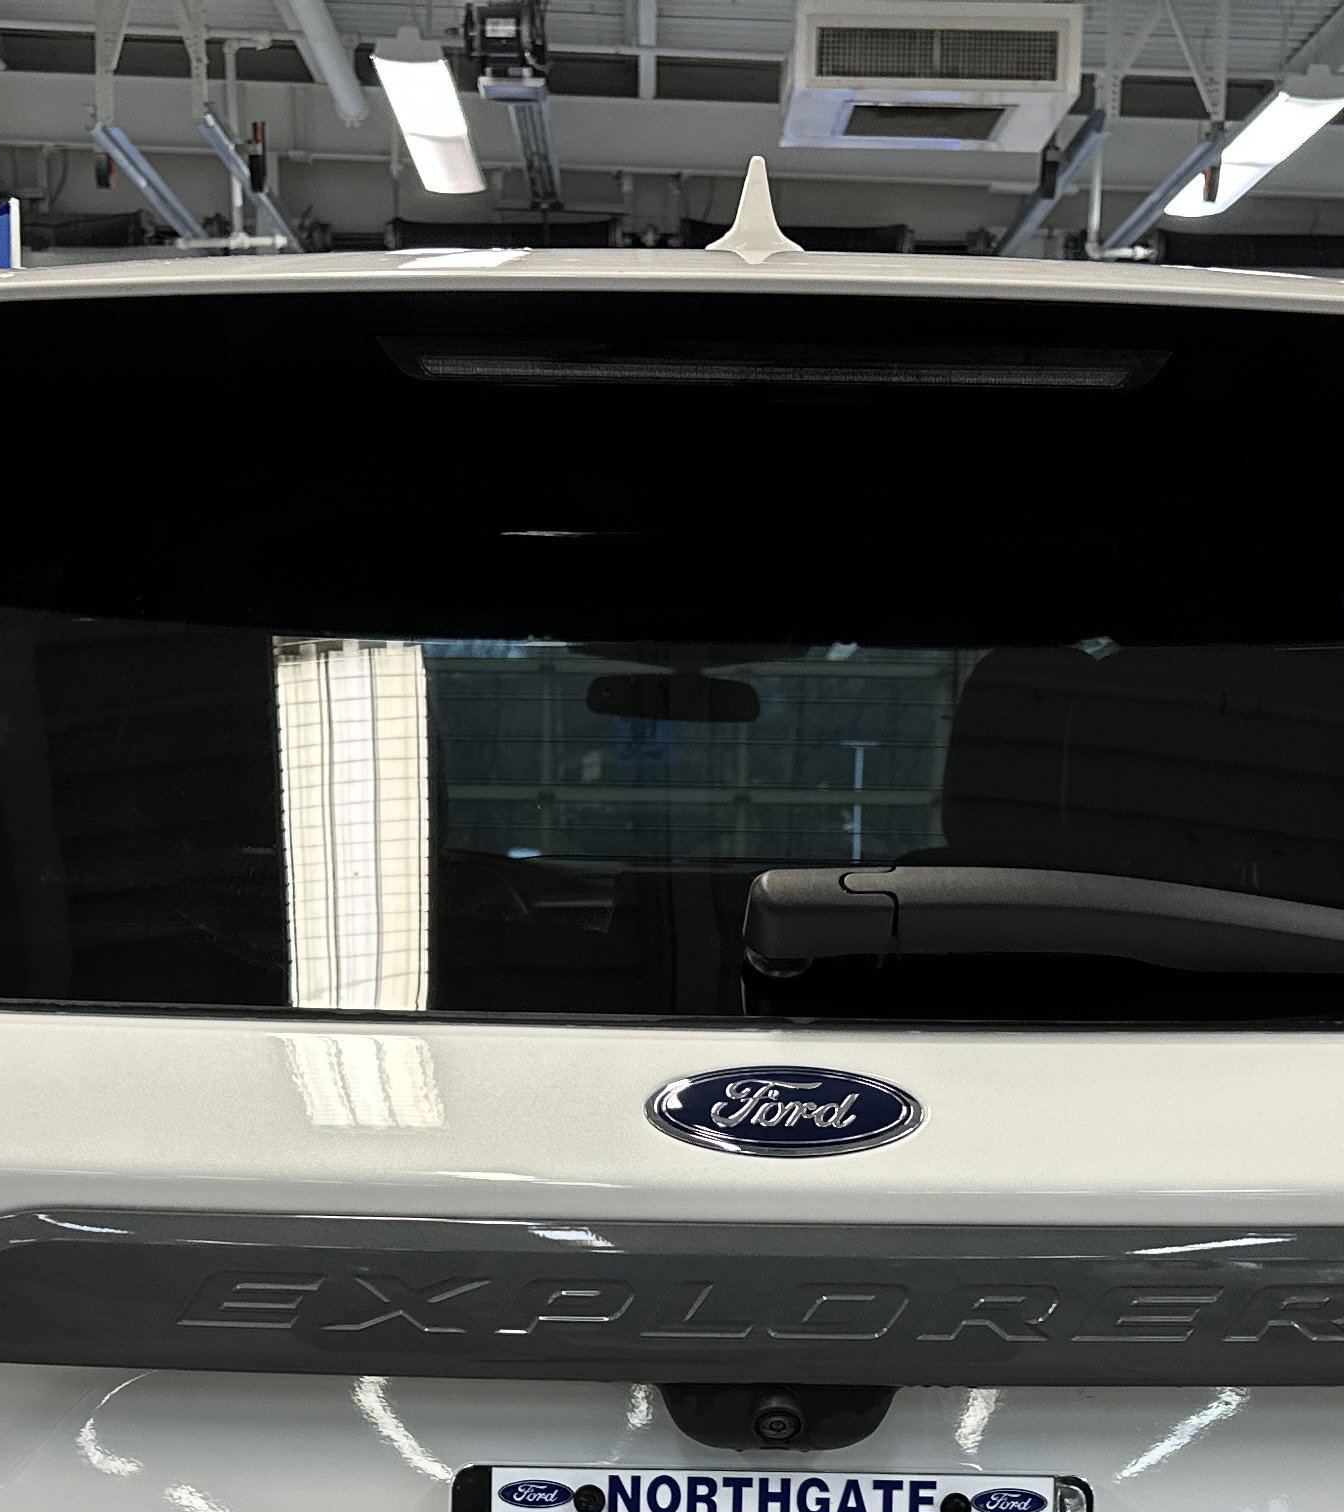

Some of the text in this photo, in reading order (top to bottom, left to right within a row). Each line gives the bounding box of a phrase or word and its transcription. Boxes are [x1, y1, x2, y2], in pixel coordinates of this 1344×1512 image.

[710, 1078, 860, 1128] Ford
[513, 1484, 559, 1502] Ford
[986, 1492, 1032, 1510] Ford
